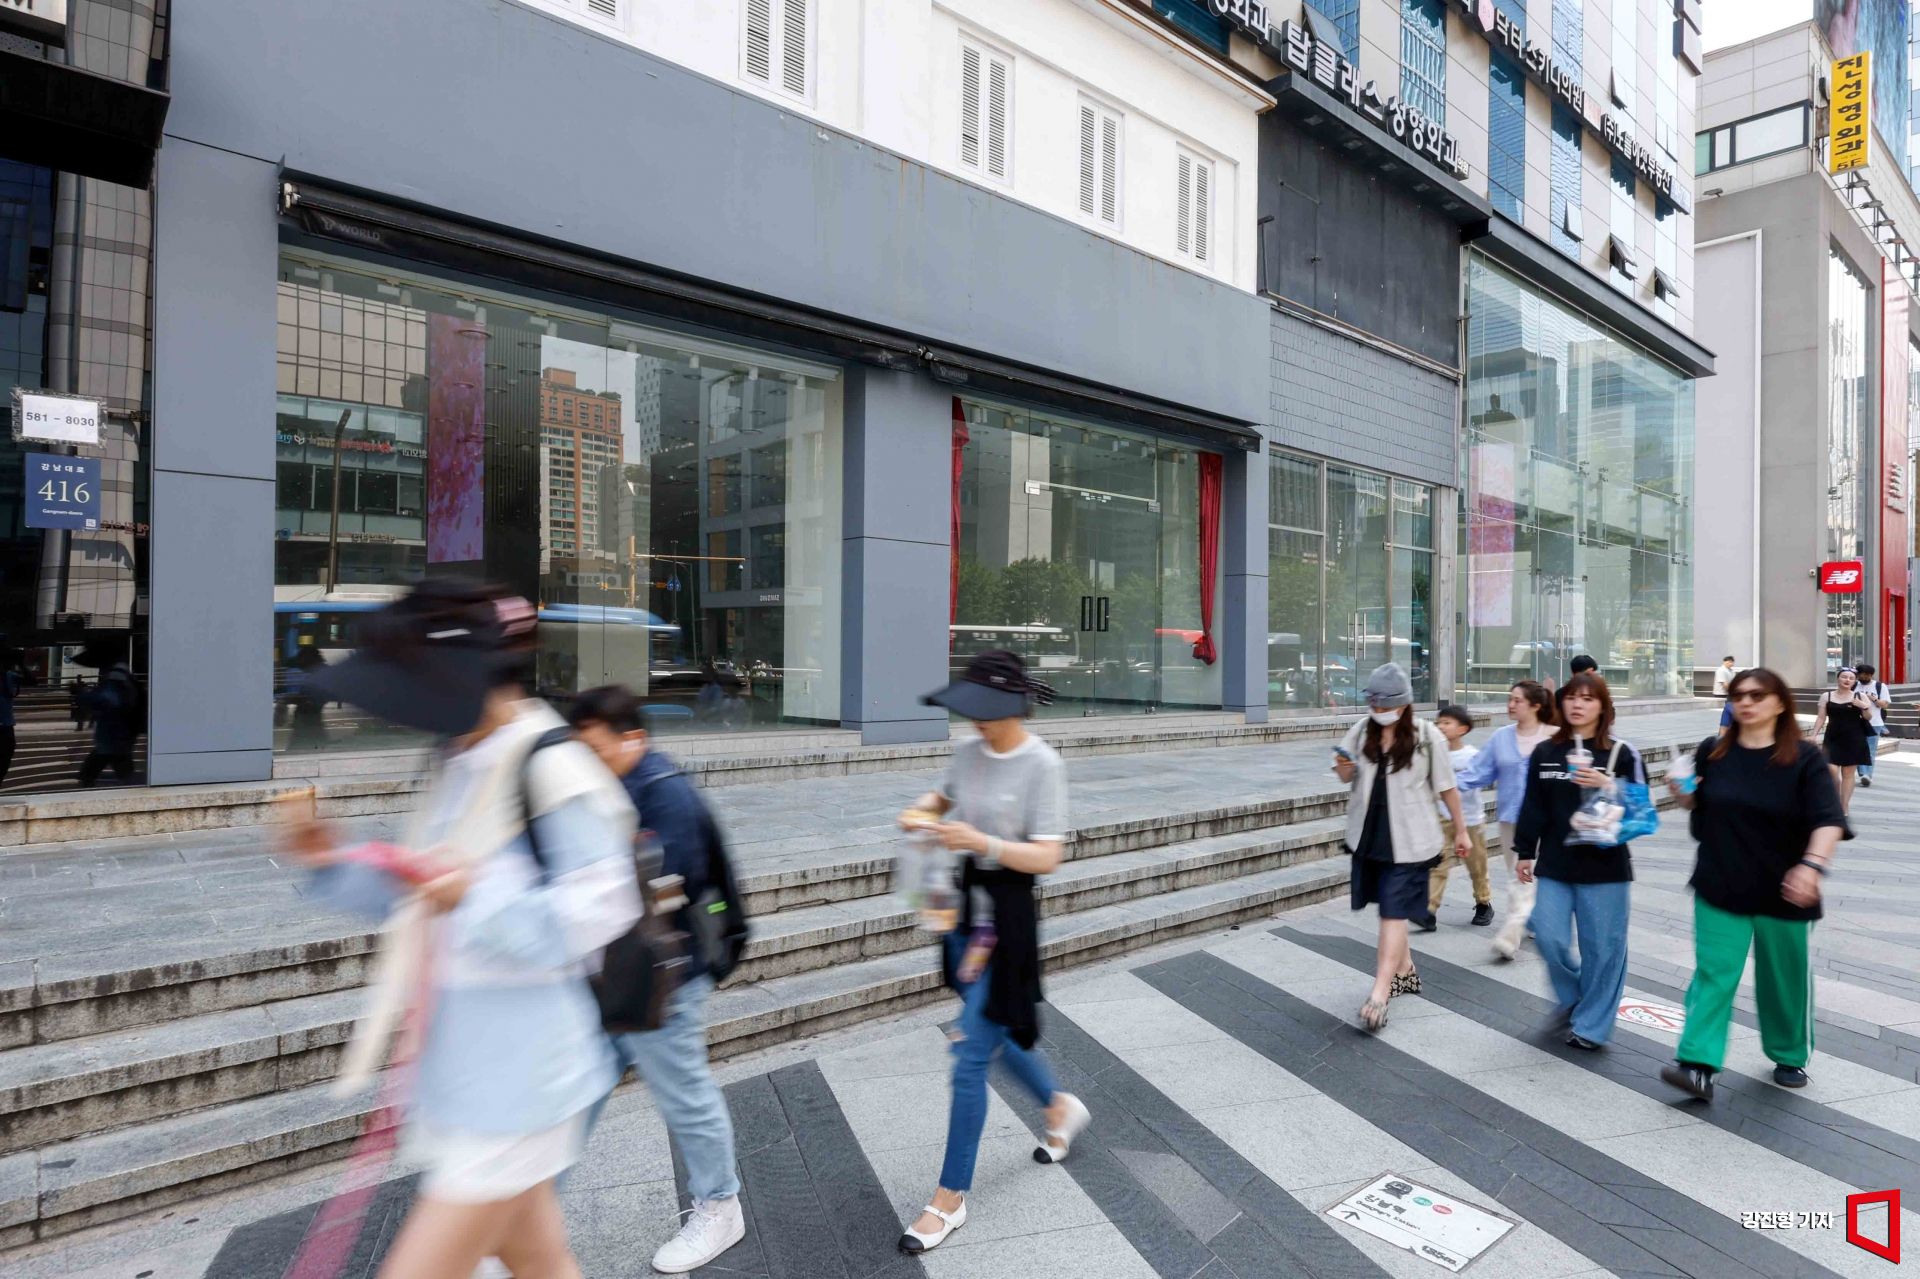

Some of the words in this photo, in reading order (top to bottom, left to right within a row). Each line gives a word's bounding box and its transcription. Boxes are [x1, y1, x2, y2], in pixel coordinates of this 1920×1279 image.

[1834, 55, 1864, 156] 진성형외과
[1837, 157, 1862, 171] 5F
[339, 222, 381, 242] WORLD
[26, 411, 49, 422] 581
[65, 415, 95, 427] 8030
[41, 462, 85, 474] 강남대로
[37, 479, 91, 504] 416
